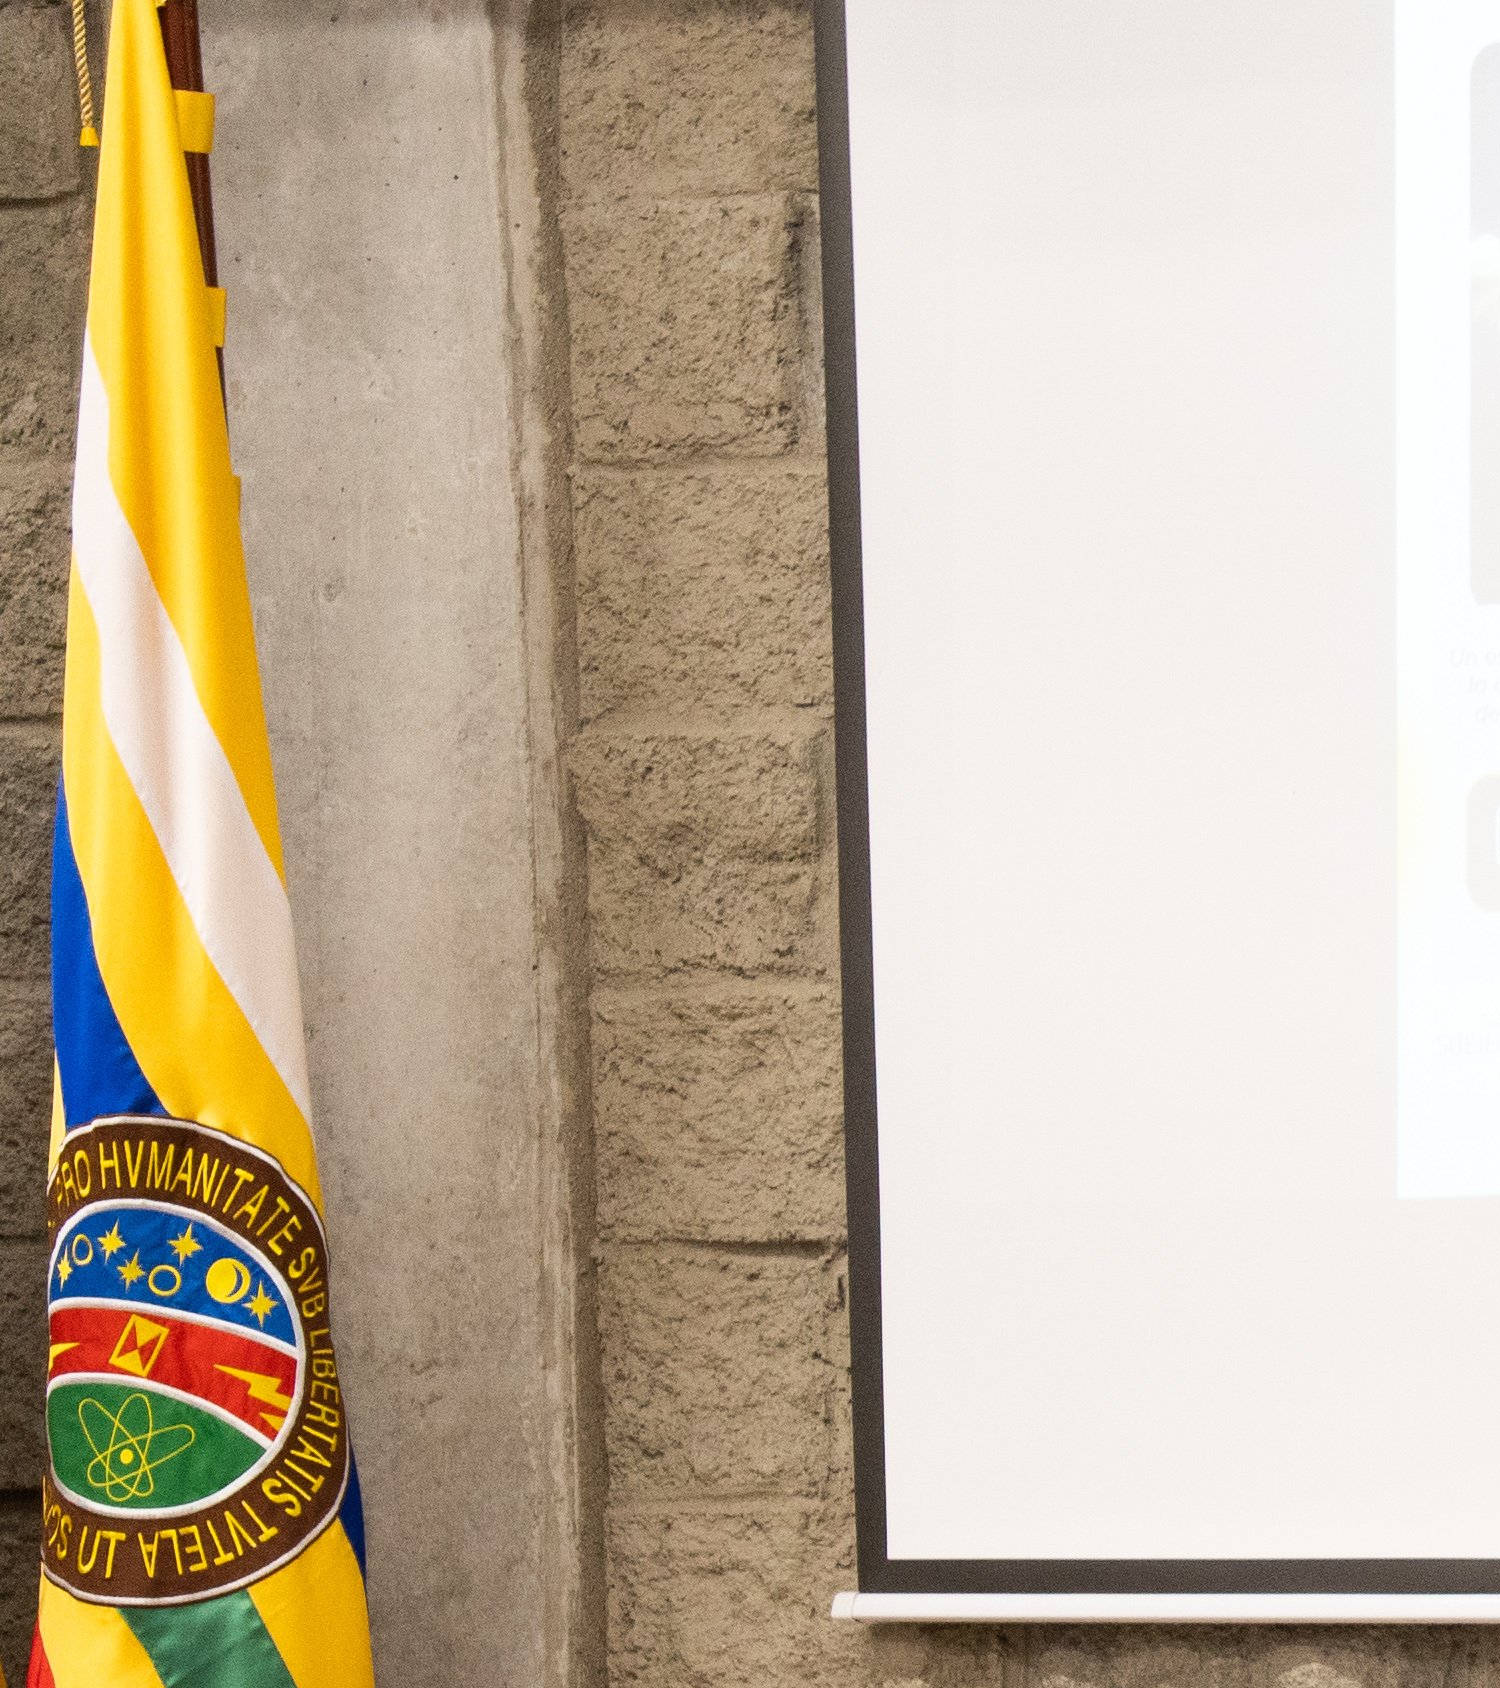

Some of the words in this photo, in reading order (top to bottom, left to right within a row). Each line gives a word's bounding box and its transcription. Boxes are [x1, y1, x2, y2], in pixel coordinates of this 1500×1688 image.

[98, 1139, 303, 1257] HVMANITATE
[287, 1246, 326, 1319] SVB
[261, 1327, 341, 1518] LIBERTATIS
[138, 1500, 278, 1578] TVTELA
